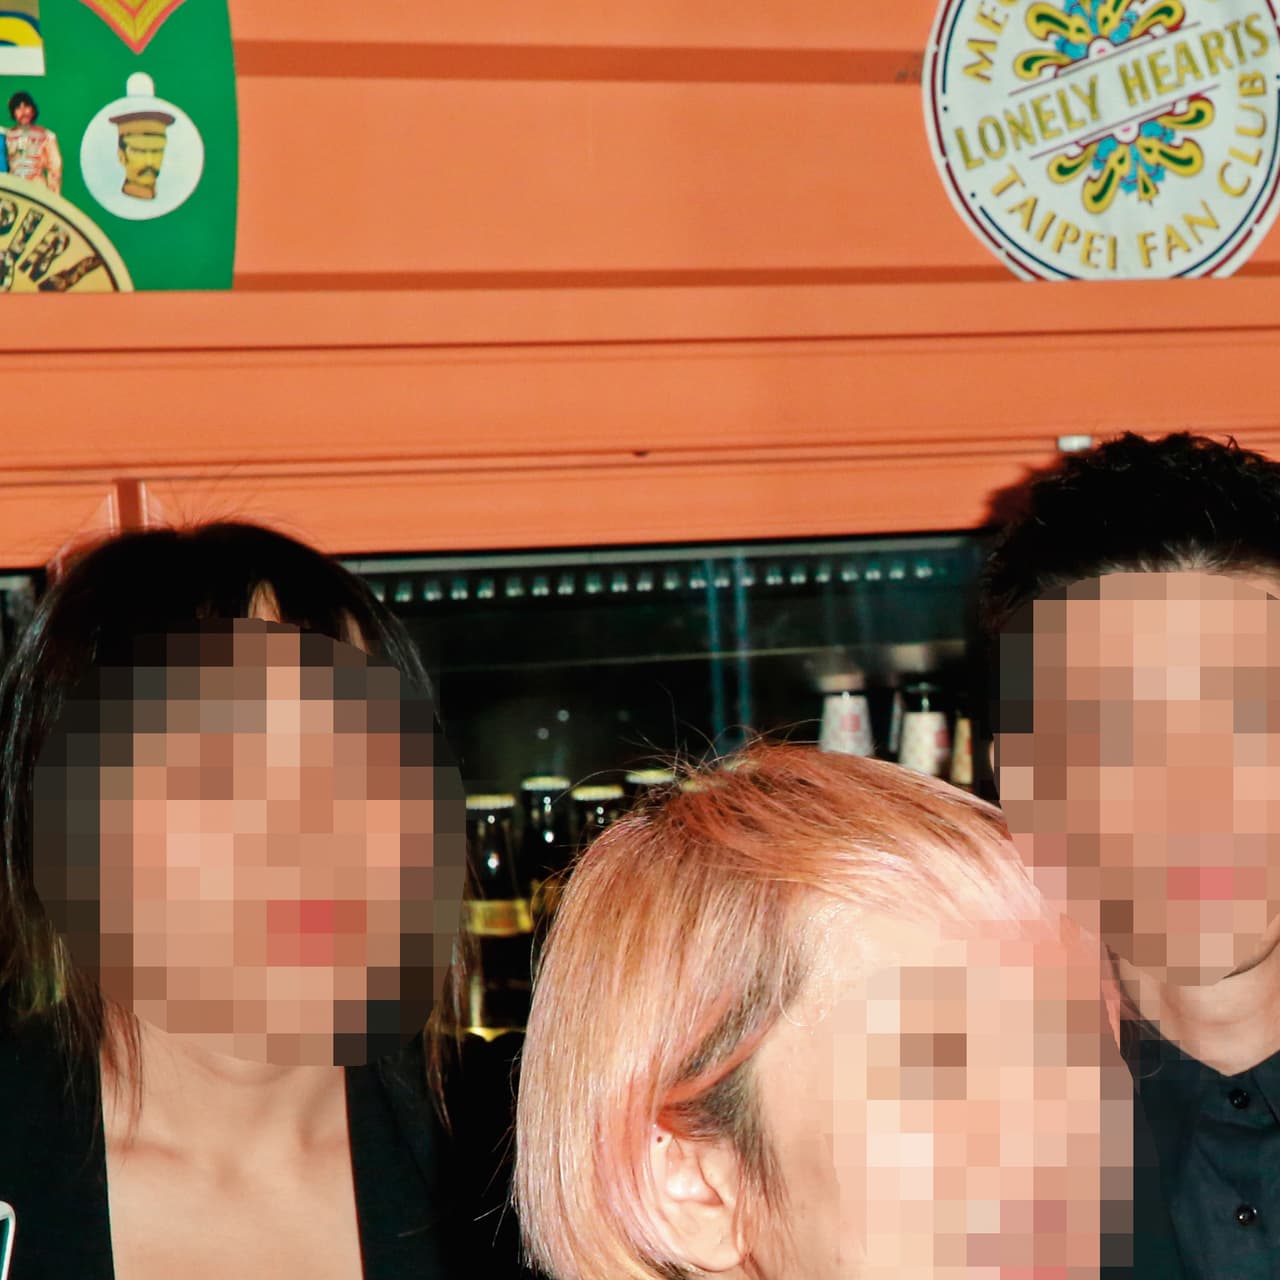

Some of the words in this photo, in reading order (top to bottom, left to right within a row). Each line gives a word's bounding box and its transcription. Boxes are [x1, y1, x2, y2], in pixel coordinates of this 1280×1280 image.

[955, 75, 1101, 171] LONELY
[1117, 12, 1270, 106] HEARTS
[990, 164, 1119, 272] TAIPEI
[1136, 200, 1221, 270] FAN
[1217, 71, 1268, 199] CLUB
